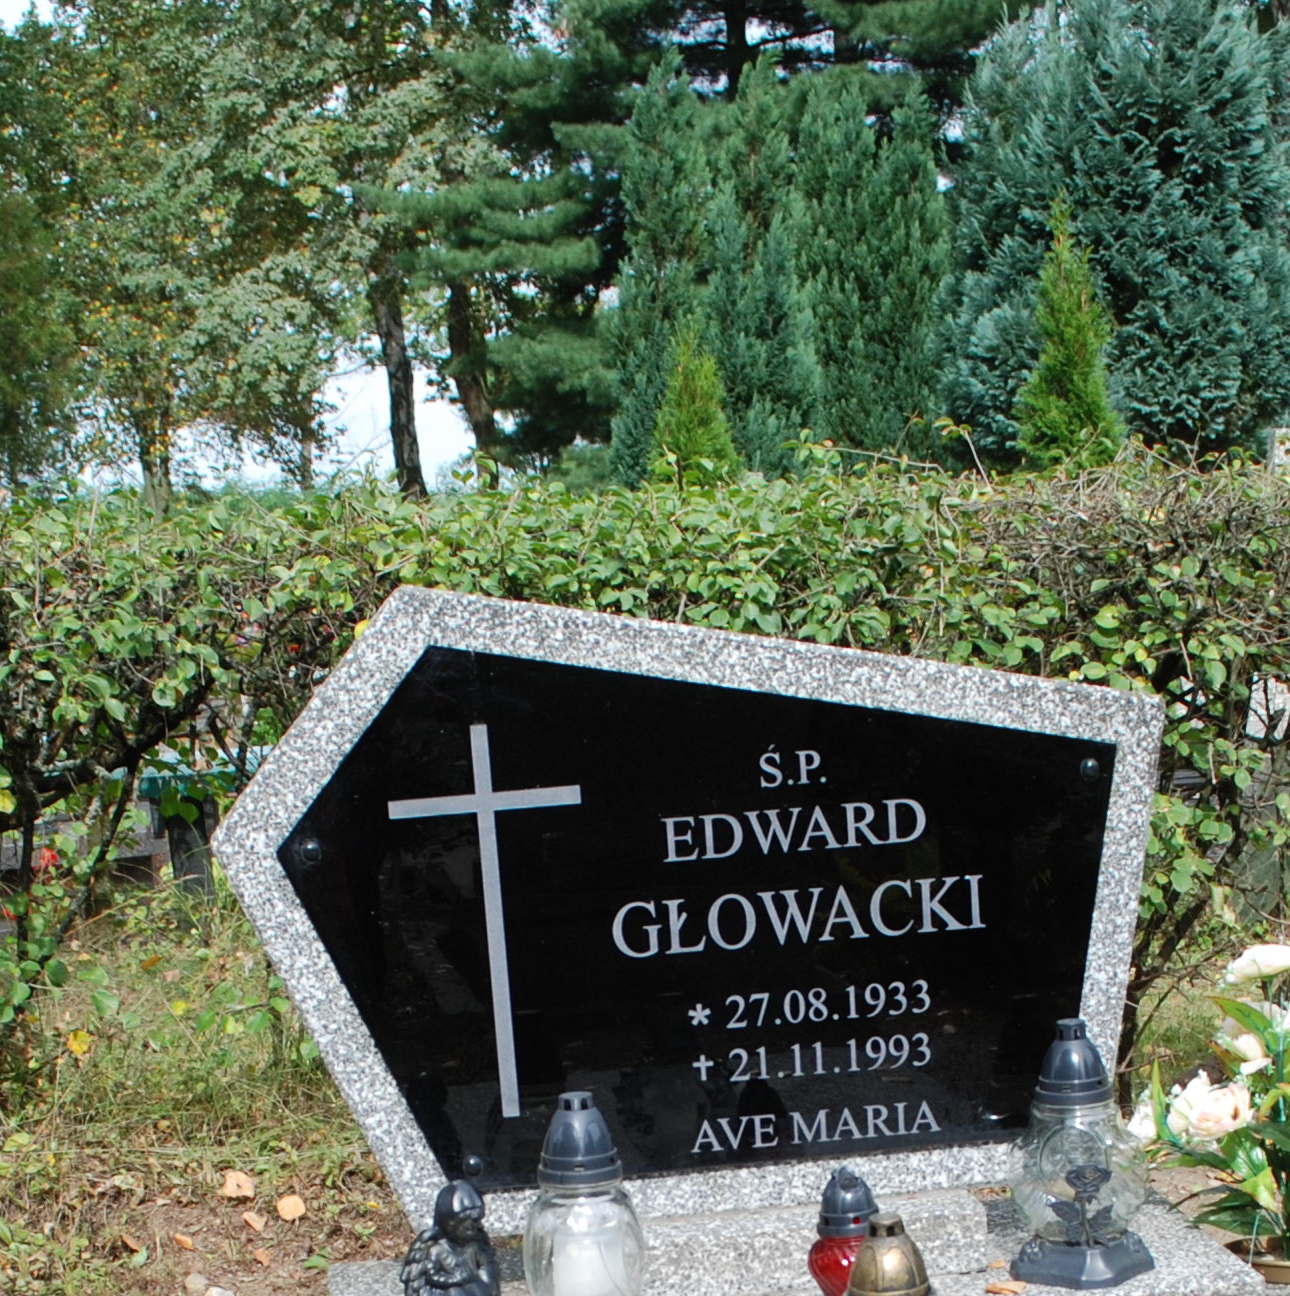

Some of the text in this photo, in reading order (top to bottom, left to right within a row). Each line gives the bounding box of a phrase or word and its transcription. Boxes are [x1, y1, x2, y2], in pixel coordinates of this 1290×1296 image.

[661, 799, 926, 862] EDWARD
[612, 875, 986, 957] GŁOWACKI
[725, 980, 931, 1028] 27.08.1933
[728, 1033, 932, 1082] 21.11.1993
[691, 1101, 942, 1152] AVE MARIA
